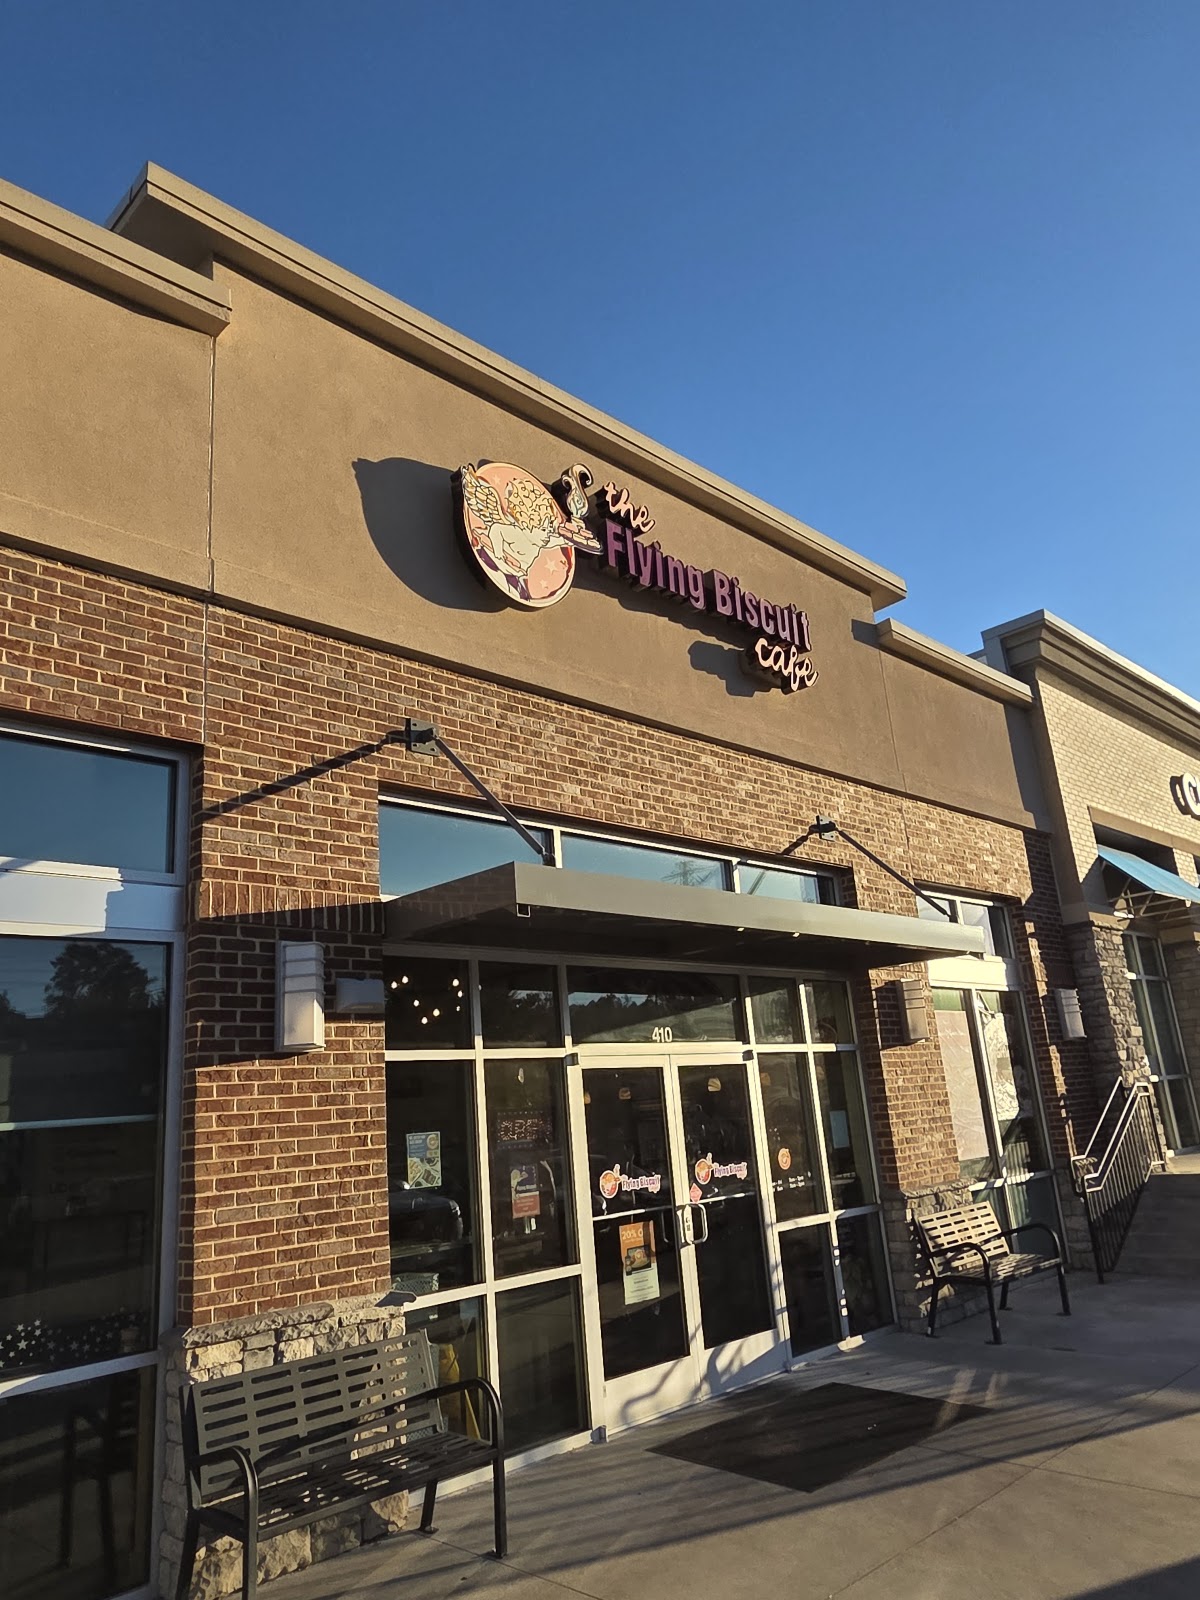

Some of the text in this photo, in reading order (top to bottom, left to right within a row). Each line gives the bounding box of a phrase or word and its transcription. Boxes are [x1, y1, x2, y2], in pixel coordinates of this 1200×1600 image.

[604, 481, 655, 533] the
[605, 518, 812, 651] Flying Biscuit
[755, 638, 818, 692] cafe
[652, 1026, 673, 1043] 410
[622, 1178, 640, 1191] Flying
